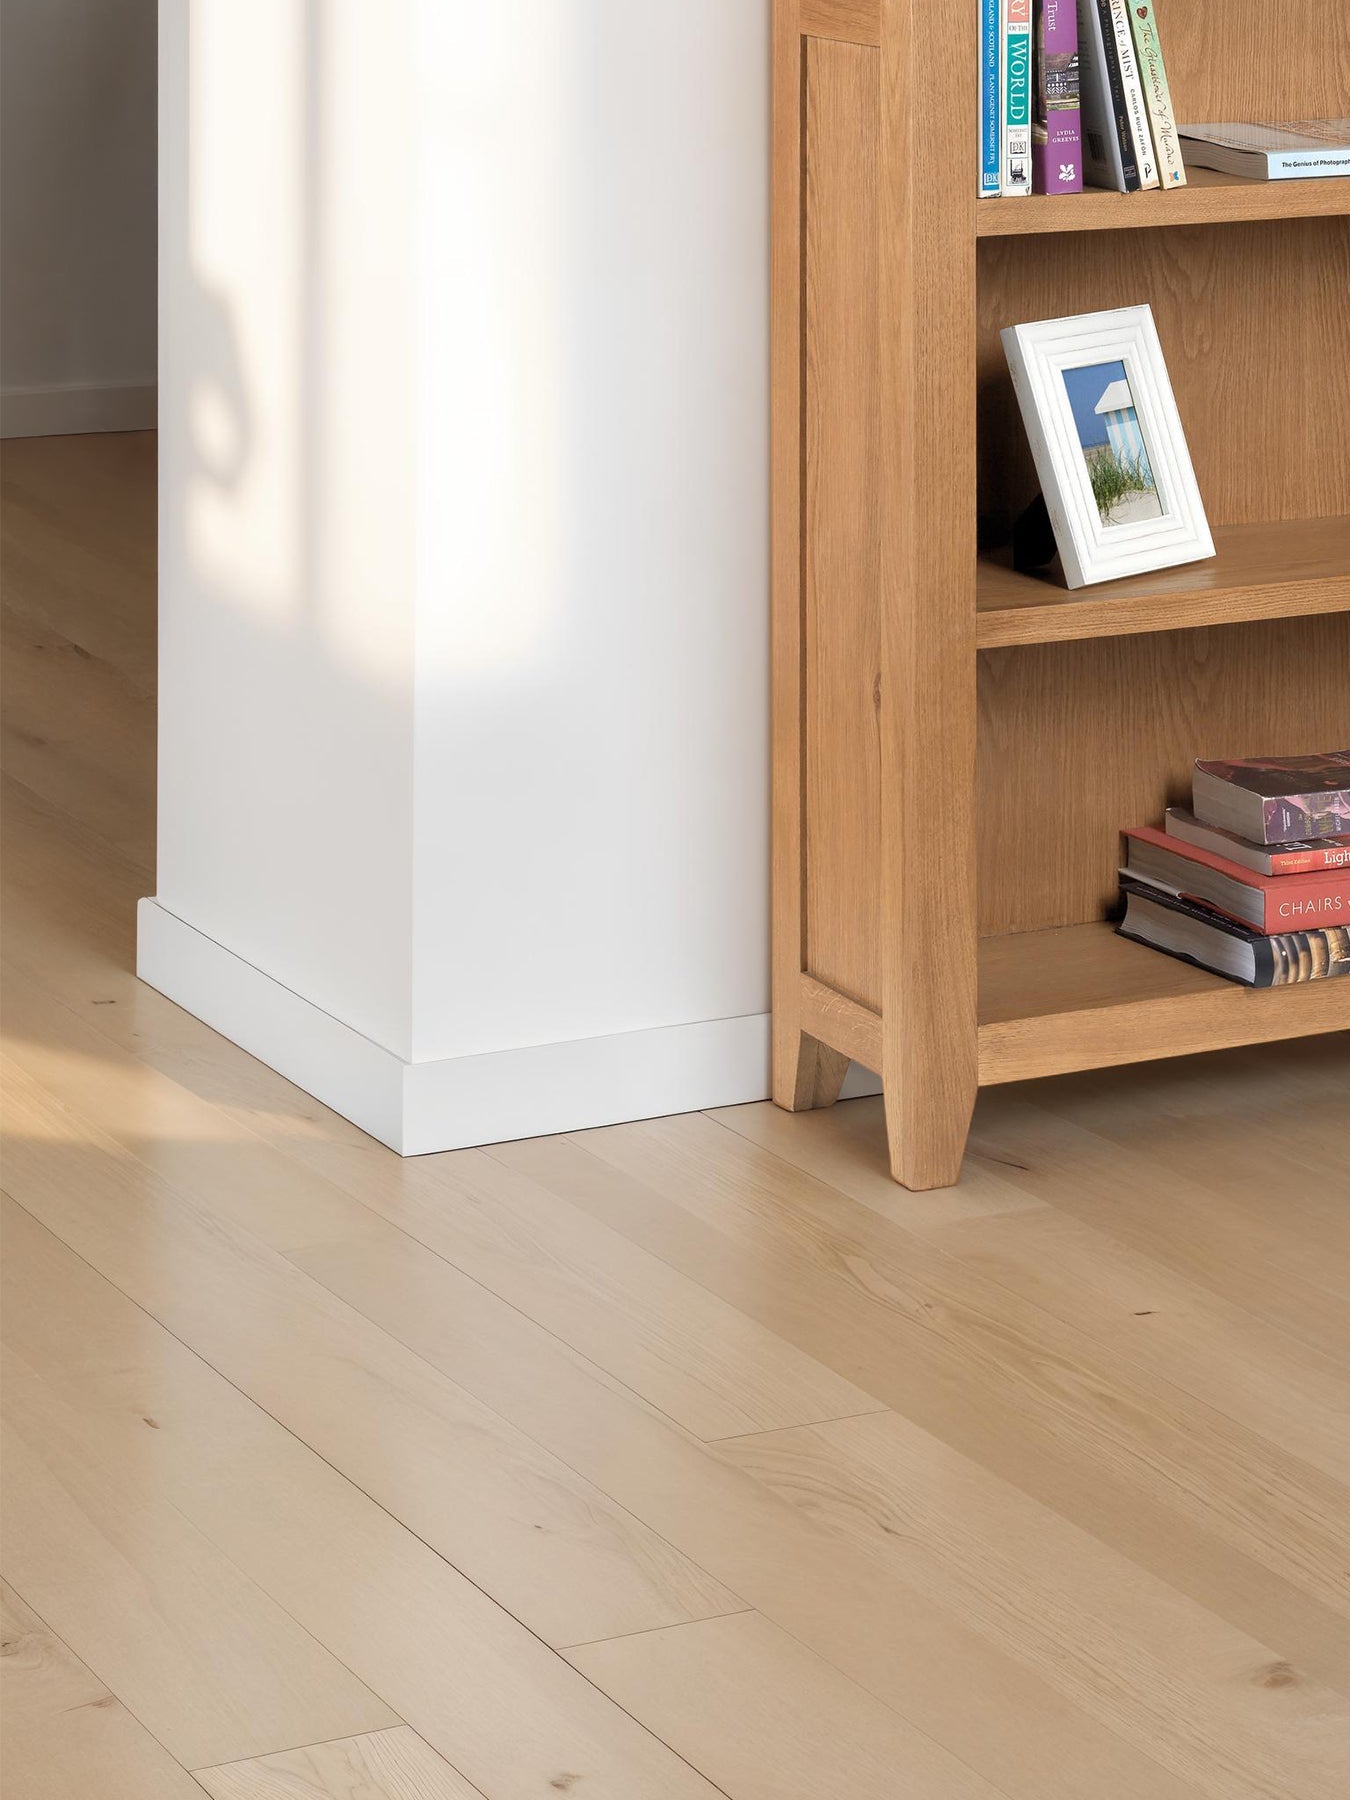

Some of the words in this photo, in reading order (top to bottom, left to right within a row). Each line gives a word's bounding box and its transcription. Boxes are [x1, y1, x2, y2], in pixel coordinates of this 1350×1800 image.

[1047, 1, 1058, 31] Trust
[1139, 22, 1155, 44] The
[1120, 49, 1134, 80] MIST
[1010, 39, 1027, 119] WORLD
[1140, 47, 1166, 106] Glassblower
[1130, 88, 1139, 115] CARLOS
[1135, 116, 1143, 132] RUIZ
[1153, 109, 1169, 120] of
[1012, 142, 1025, 152] DK
[1138, 134, 1147, 156] ZAFÓN
[1160, 121, 1174, 166] Murano
[985, 173, 998, 184] DK
[1279, 896, 1342, 917] CHAIRS
